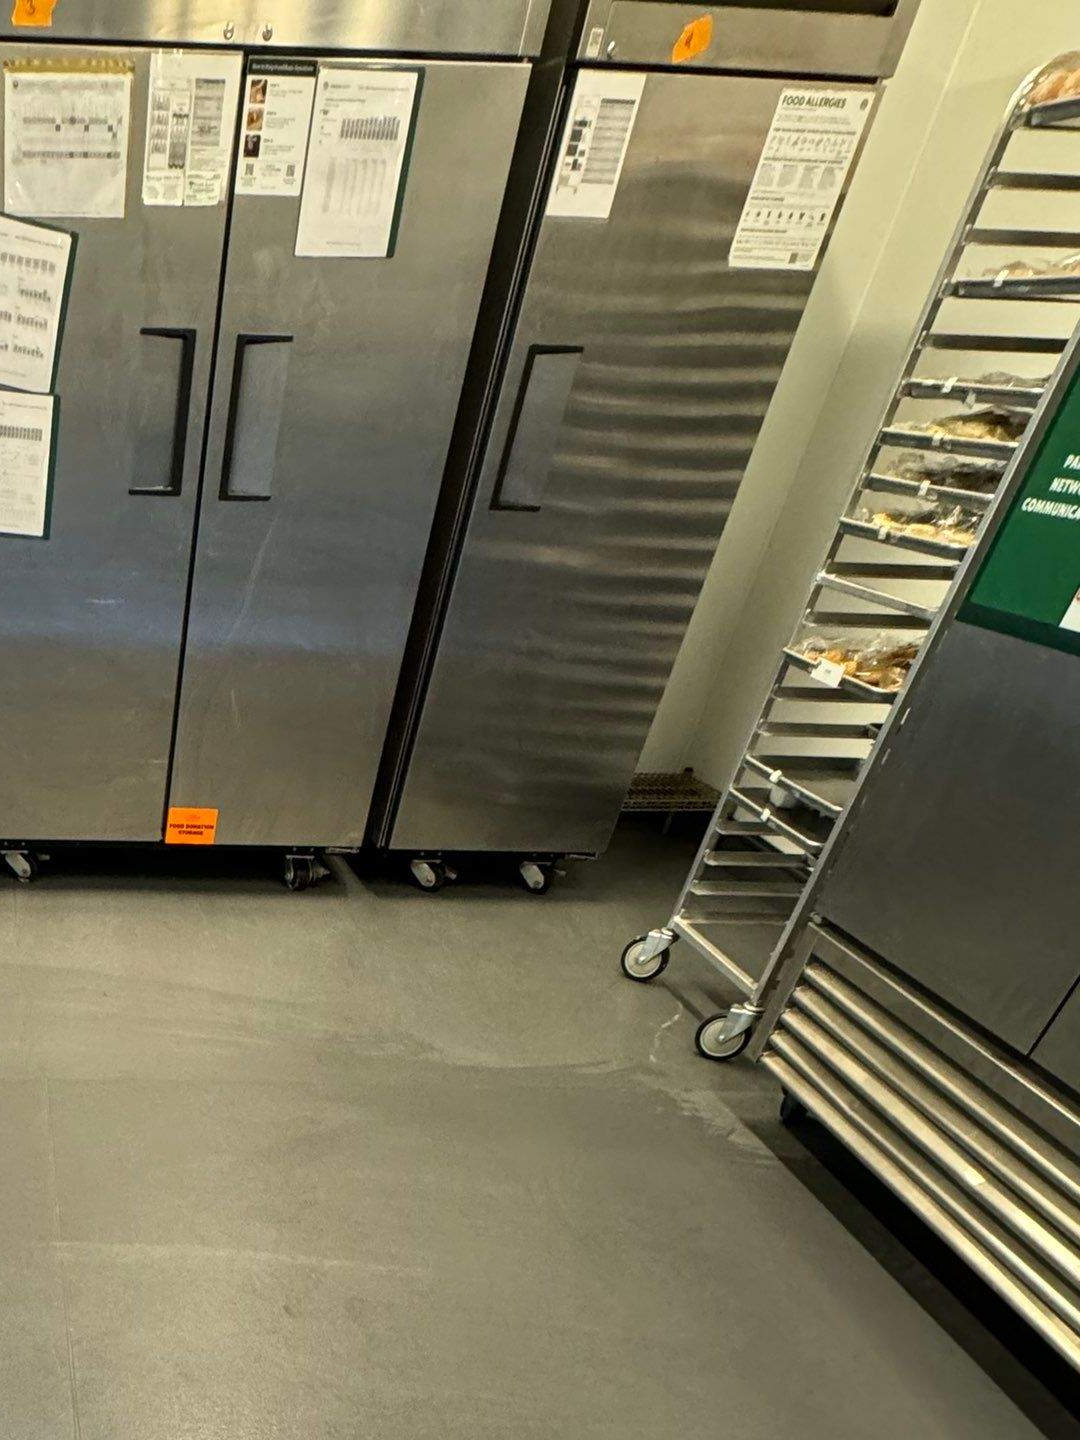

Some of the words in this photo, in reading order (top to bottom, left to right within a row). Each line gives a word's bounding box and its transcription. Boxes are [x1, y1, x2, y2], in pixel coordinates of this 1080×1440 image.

[782, 95, 805, 106] FOOD
[805, 96, 847, 109] ALLERGIES
[1049, 477, 1080, 496] NETW
